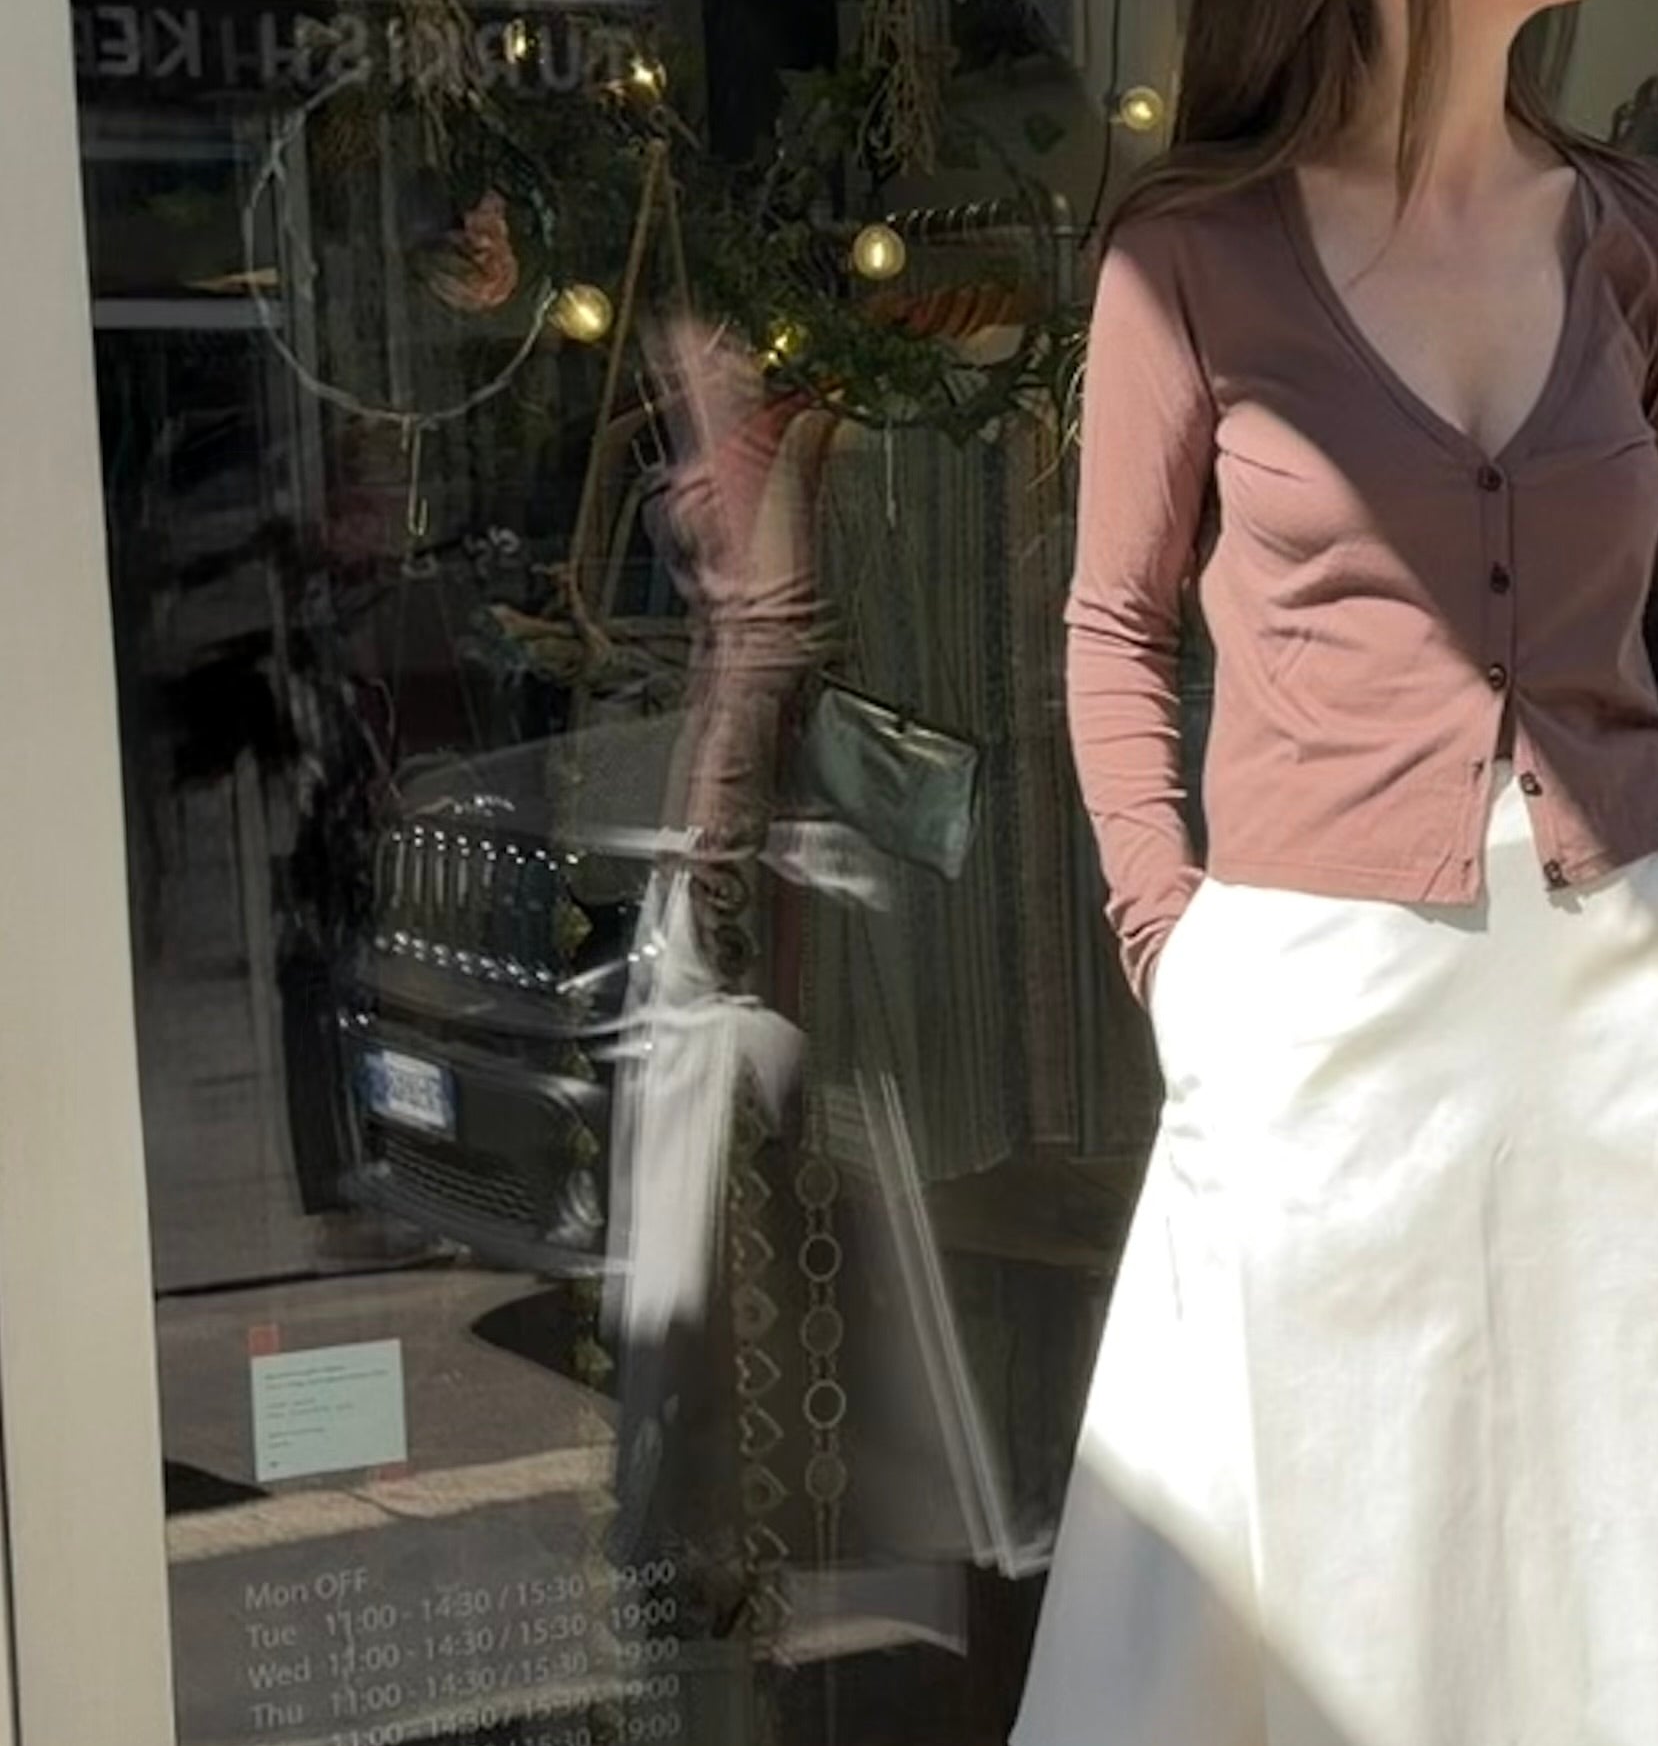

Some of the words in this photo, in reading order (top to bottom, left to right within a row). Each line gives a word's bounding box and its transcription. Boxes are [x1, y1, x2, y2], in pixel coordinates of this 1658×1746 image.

[245, 1582, 309, 1610] Mon
[314, 1567, 368, 1600] OFF
[246, 1623, 297, 1649] Tue
[518, 1573, 584, 1606] 15:30
[248, 1655, 310, 1690] Wed
[329, 1644, 399, 1676] 11:00
[425, 1627, 493, 1661] 14:30
[520, 1613, 587, 1645] 15:30
[612, 1597, 676, 1631] 19:00
[253, 1704, 303, 1729] Thu
[331, 1683, 401, 1717] 11:00
[427, 1666, 496, 1699] 14:30
[617, 1712, 682, 1746] 19:00
